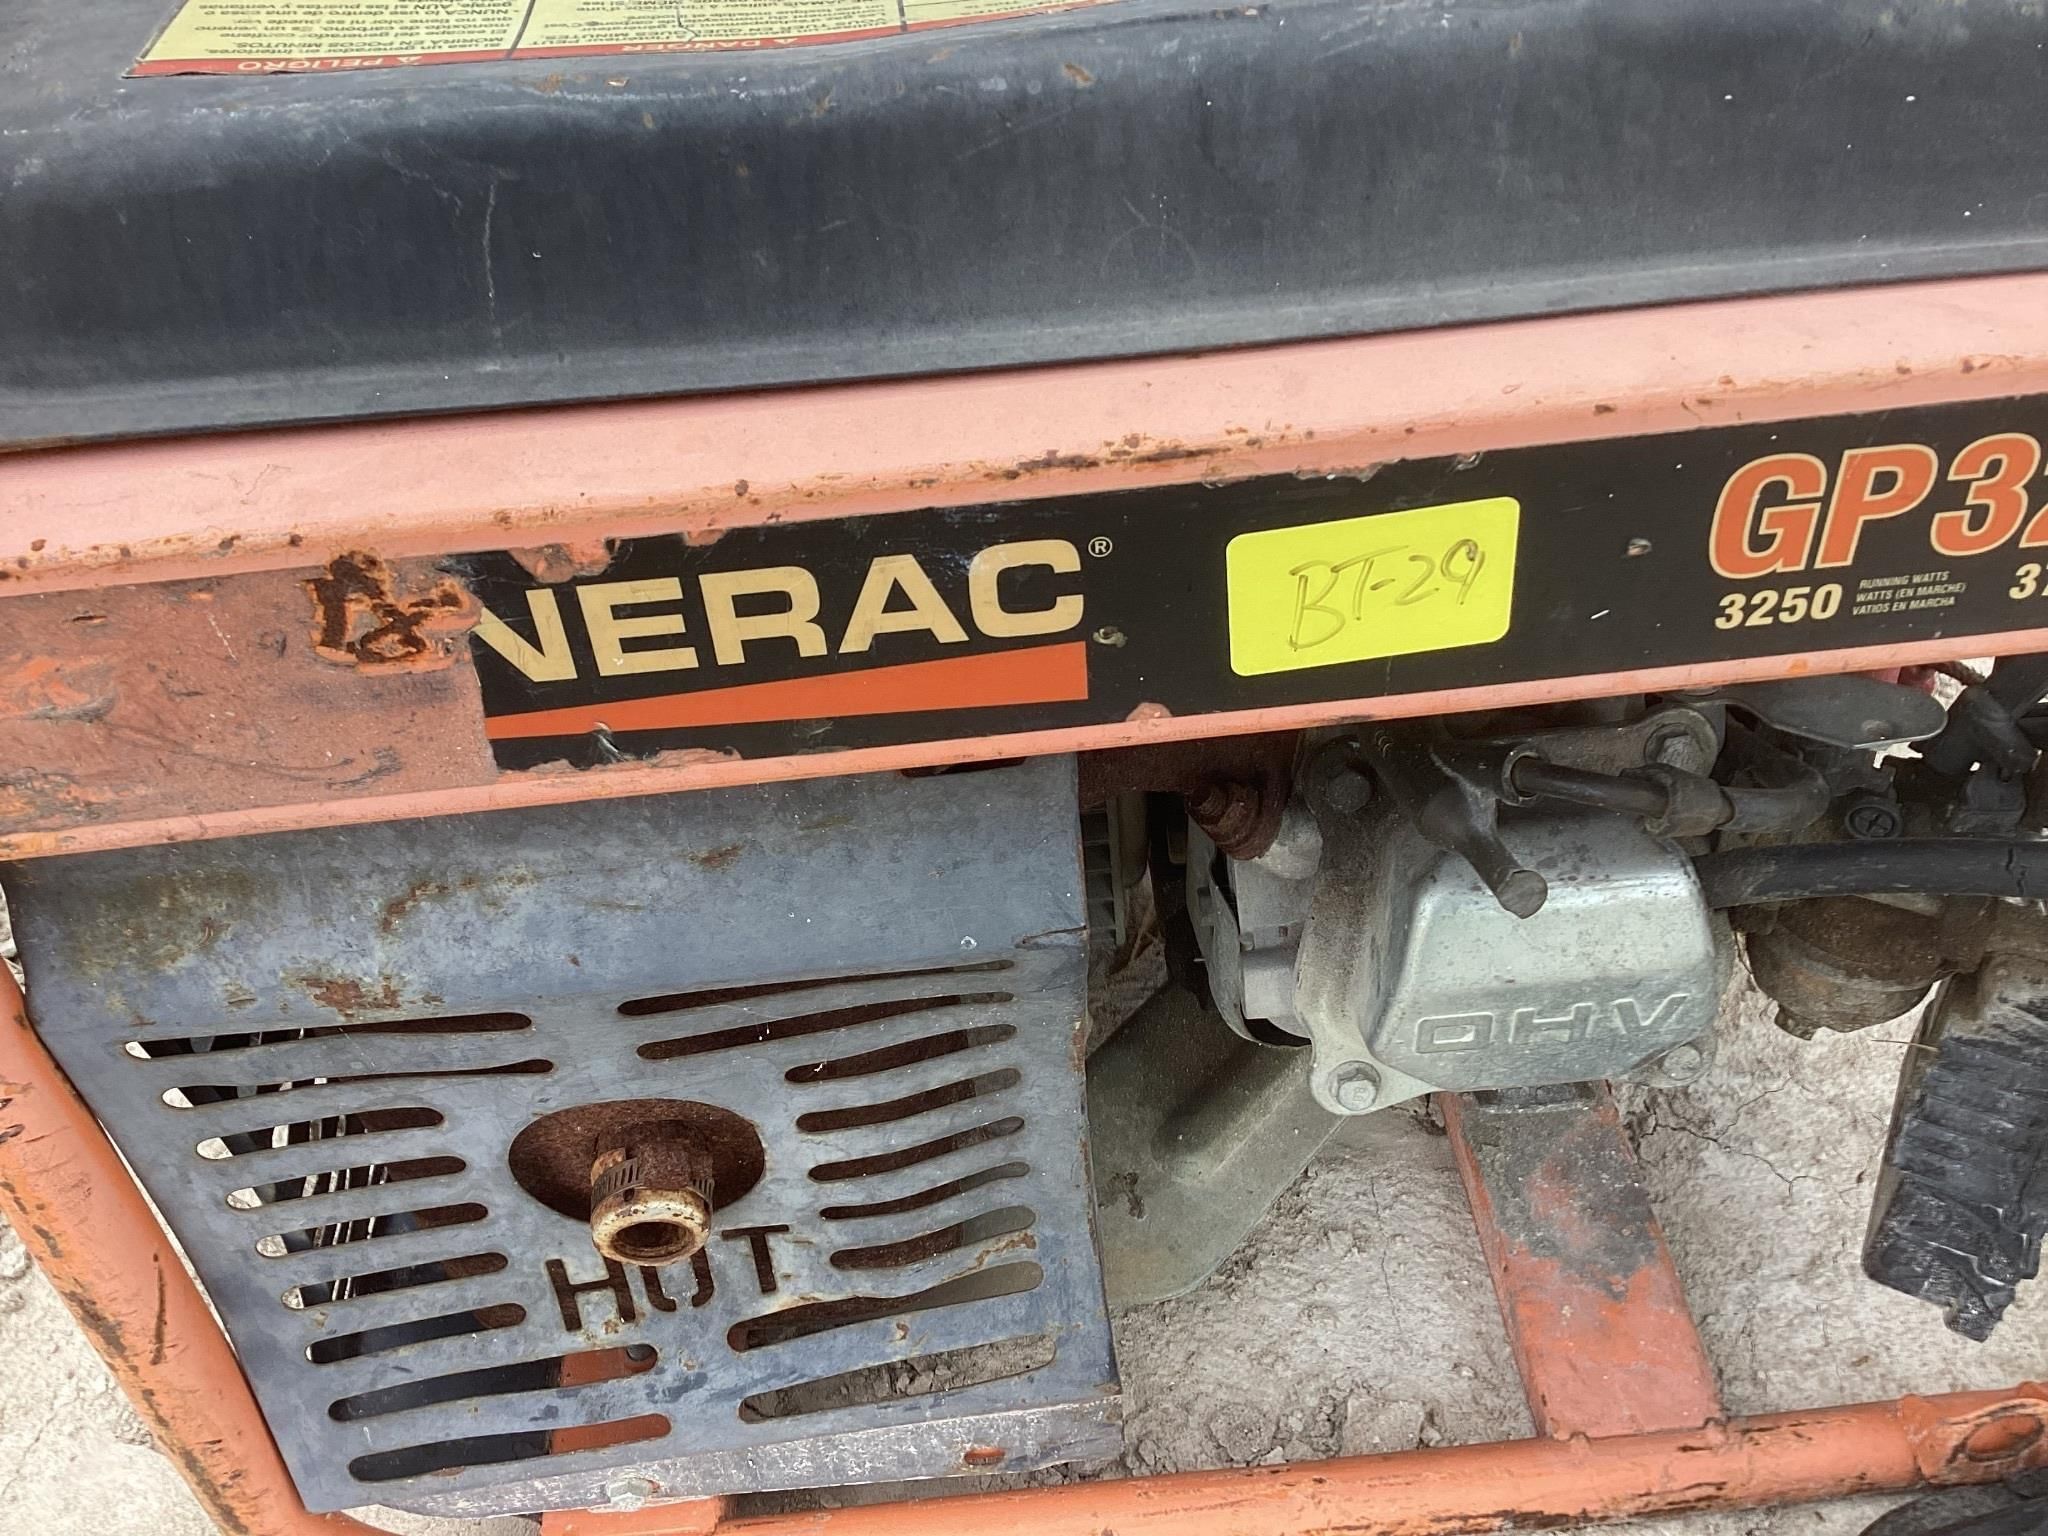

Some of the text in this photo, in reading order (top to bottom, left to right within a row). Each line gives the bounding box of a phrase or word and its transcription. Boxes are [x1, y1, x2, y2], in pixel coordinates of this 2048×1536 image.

[622, 40, 760, 51] DANGER
[238, 58, 383, 70] PELIGRO
[1859, 571, 1950, 589] RUNNING WATTS
[2009, 563, 2048, 599] 3
[1288, 538, 1485, 651] BT-29
[1856, 582, 1967, 602] WATTS (EN MARCHE)
[1714, 583, 1843, 630] 3250
[1852, 596, 1955, 615] VATIOS EN MARCHA
[1413, 993, 1691, 1054] OHV
